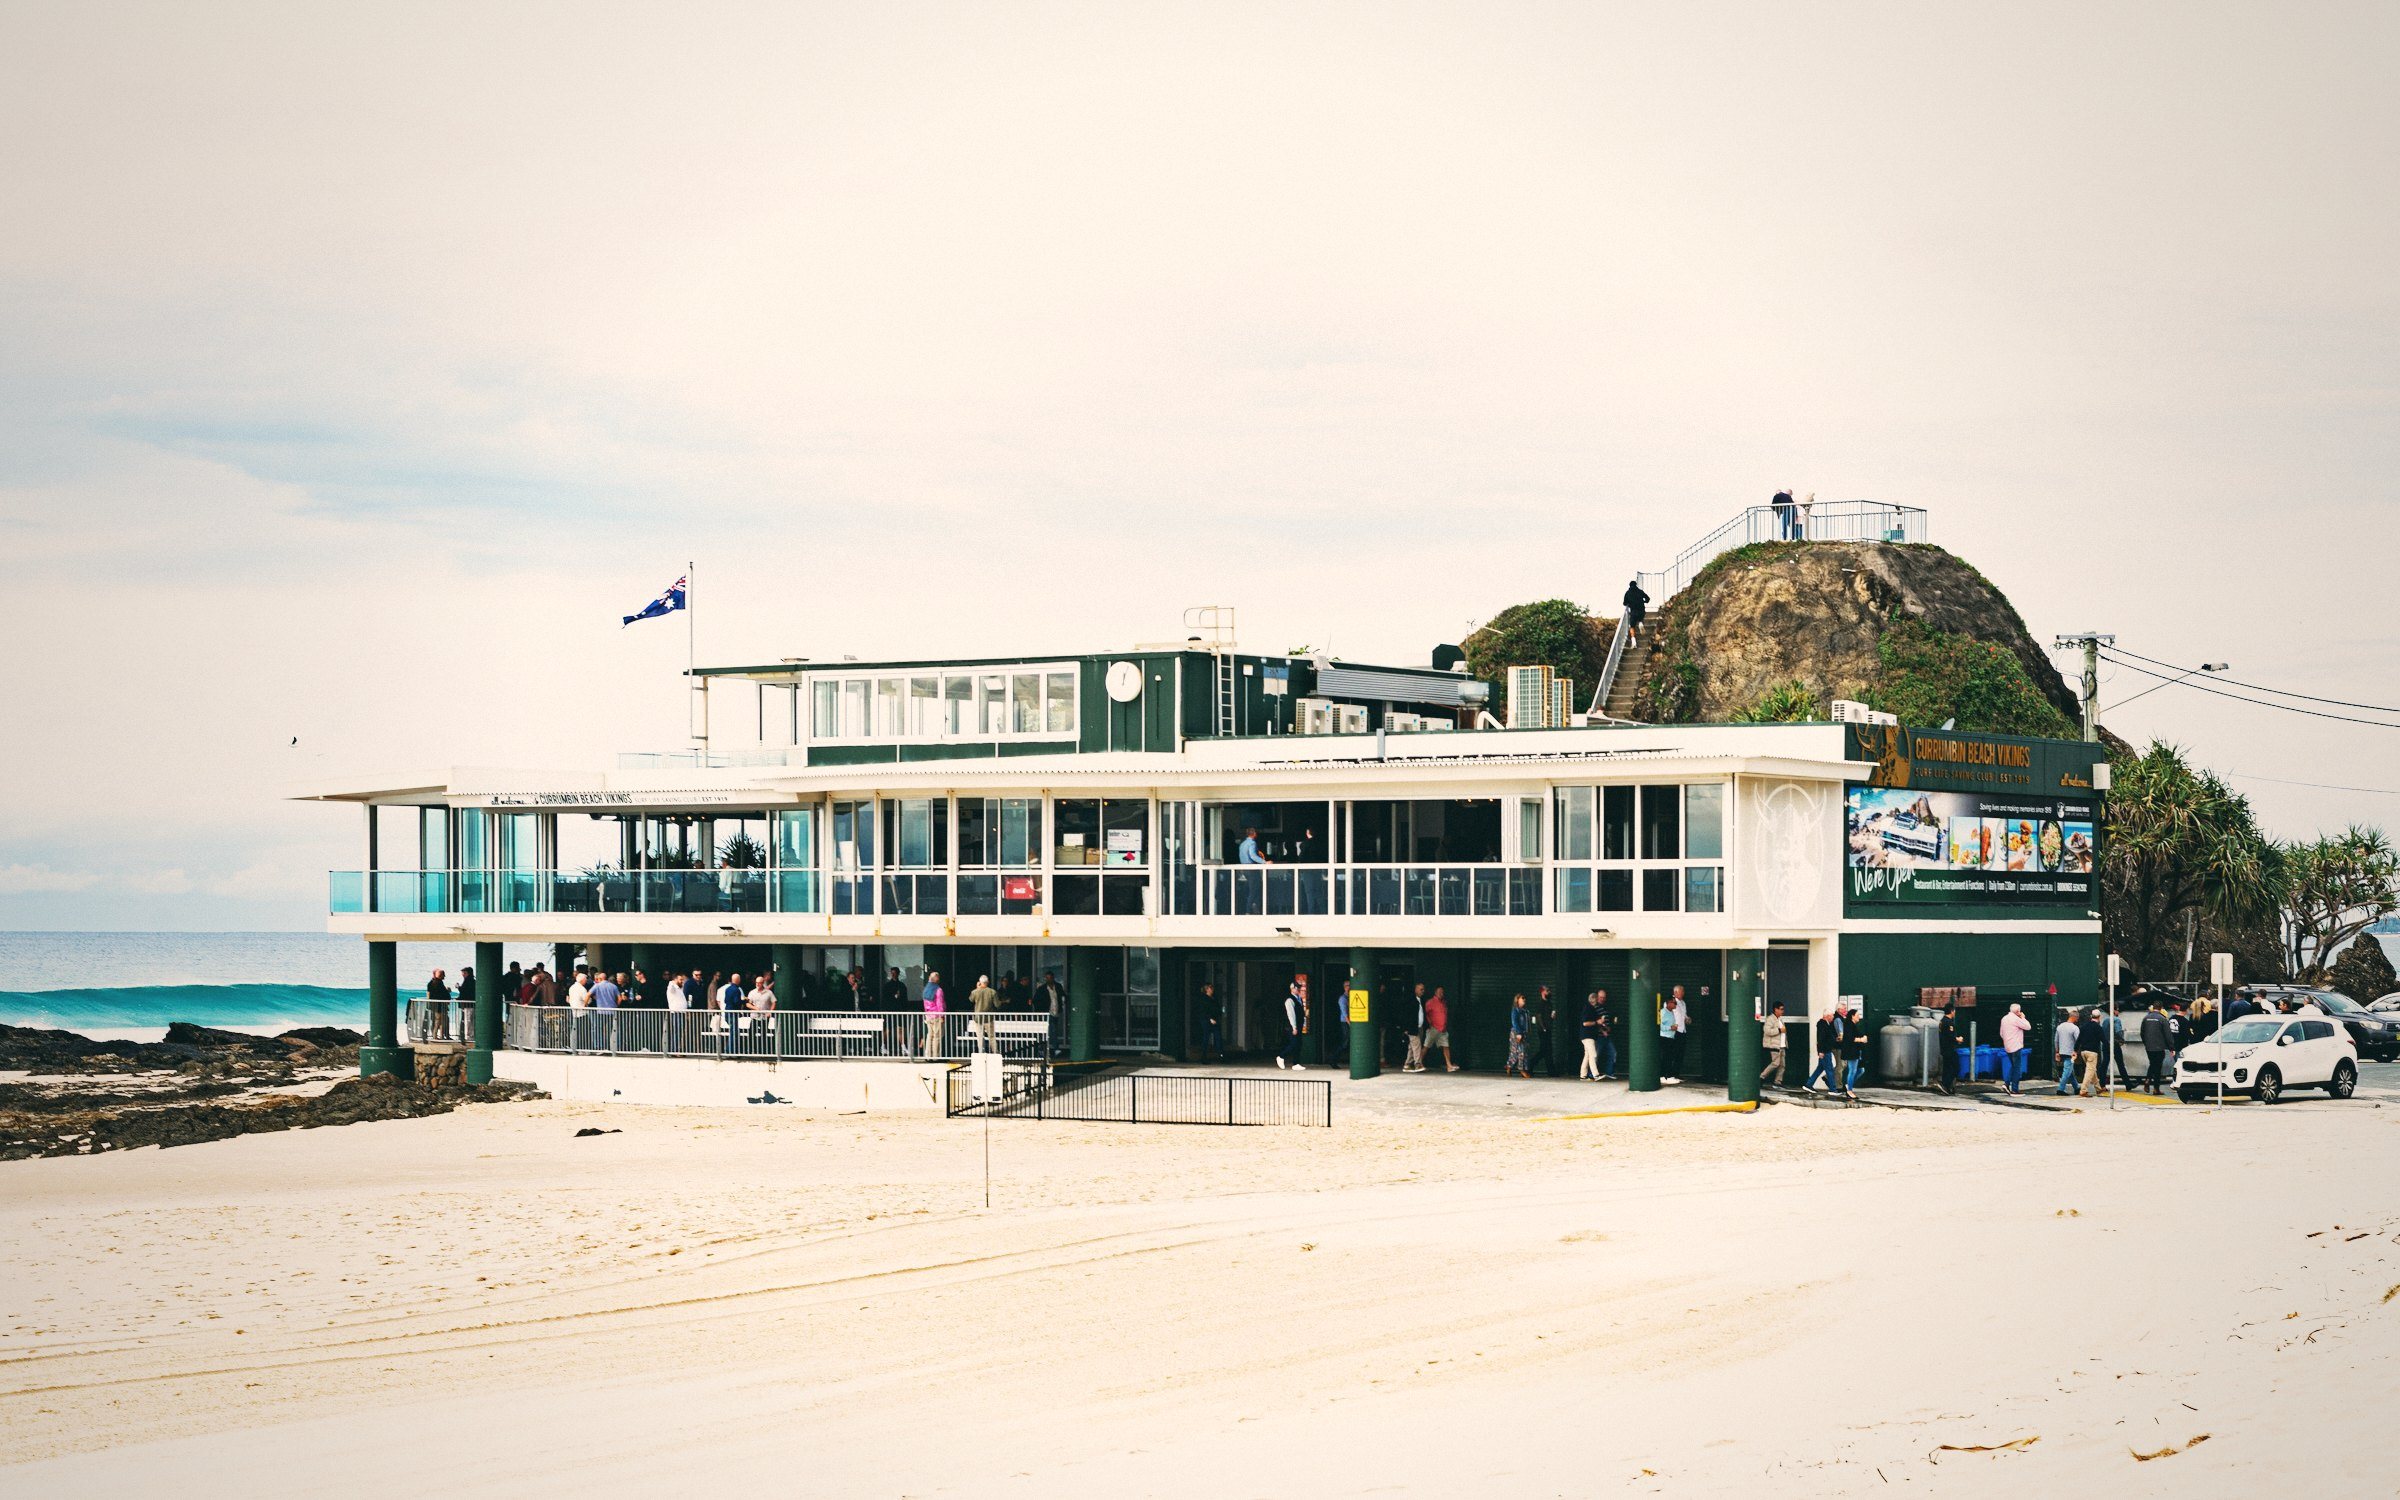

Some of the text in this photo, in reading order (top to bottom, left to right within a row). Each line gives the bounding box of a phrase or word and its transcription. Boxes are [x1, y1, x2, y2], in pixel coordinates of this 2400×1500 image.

[1916, 737, 2031, 768] CURRUMBIN BEACH VIKINGS
[1915, 768, 1932, 778] SURF
[1952, 771, 1974, 781] SAVING
[1976, 772, 1994, 782] CLUB
[540, 794, 578, 805] CURRUMBIN
[581, 794, 603, 804] BEACH
[605, 793, 633, 804] VIKINGS
[1887, 857, 1917, 899] Open
